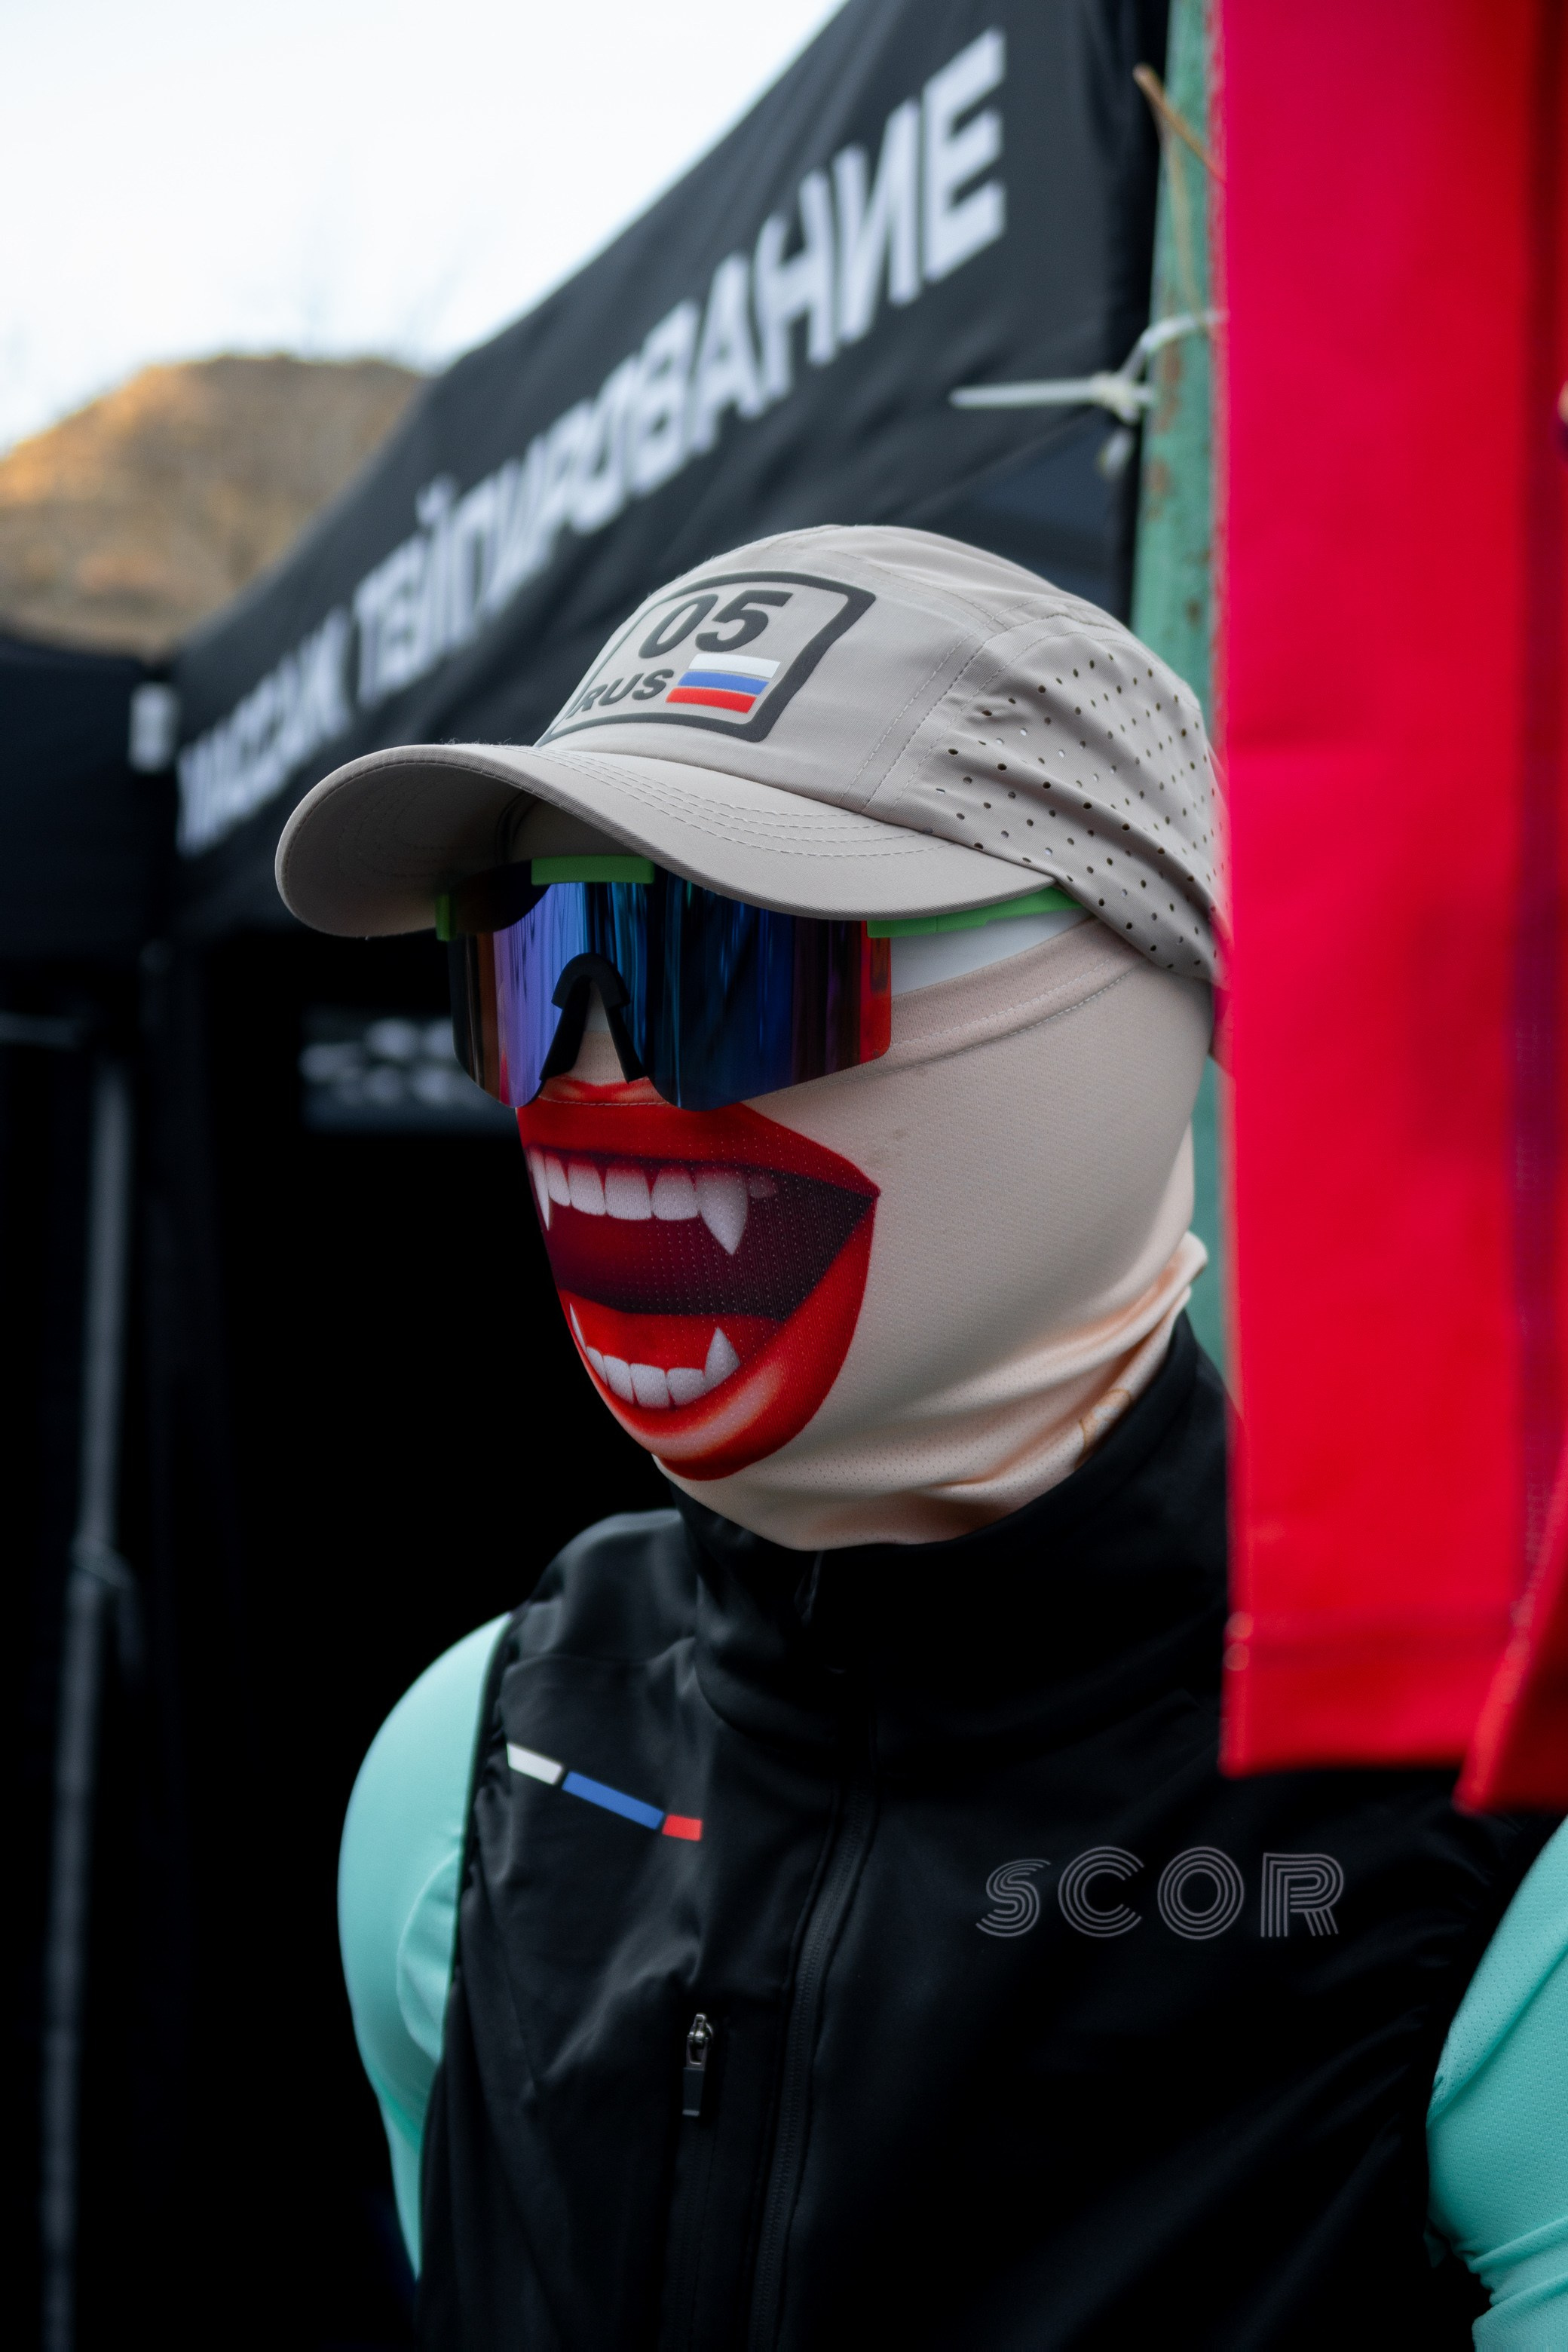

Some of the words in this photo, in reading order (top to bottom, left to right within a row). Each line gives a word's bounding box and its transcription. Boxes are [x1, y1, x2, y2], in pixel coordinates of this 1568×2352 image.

[638, 589, 794, 659] 05
[568, 669, 674, 719] RUS
[975, 1845, 1344, 1940] SCOR
